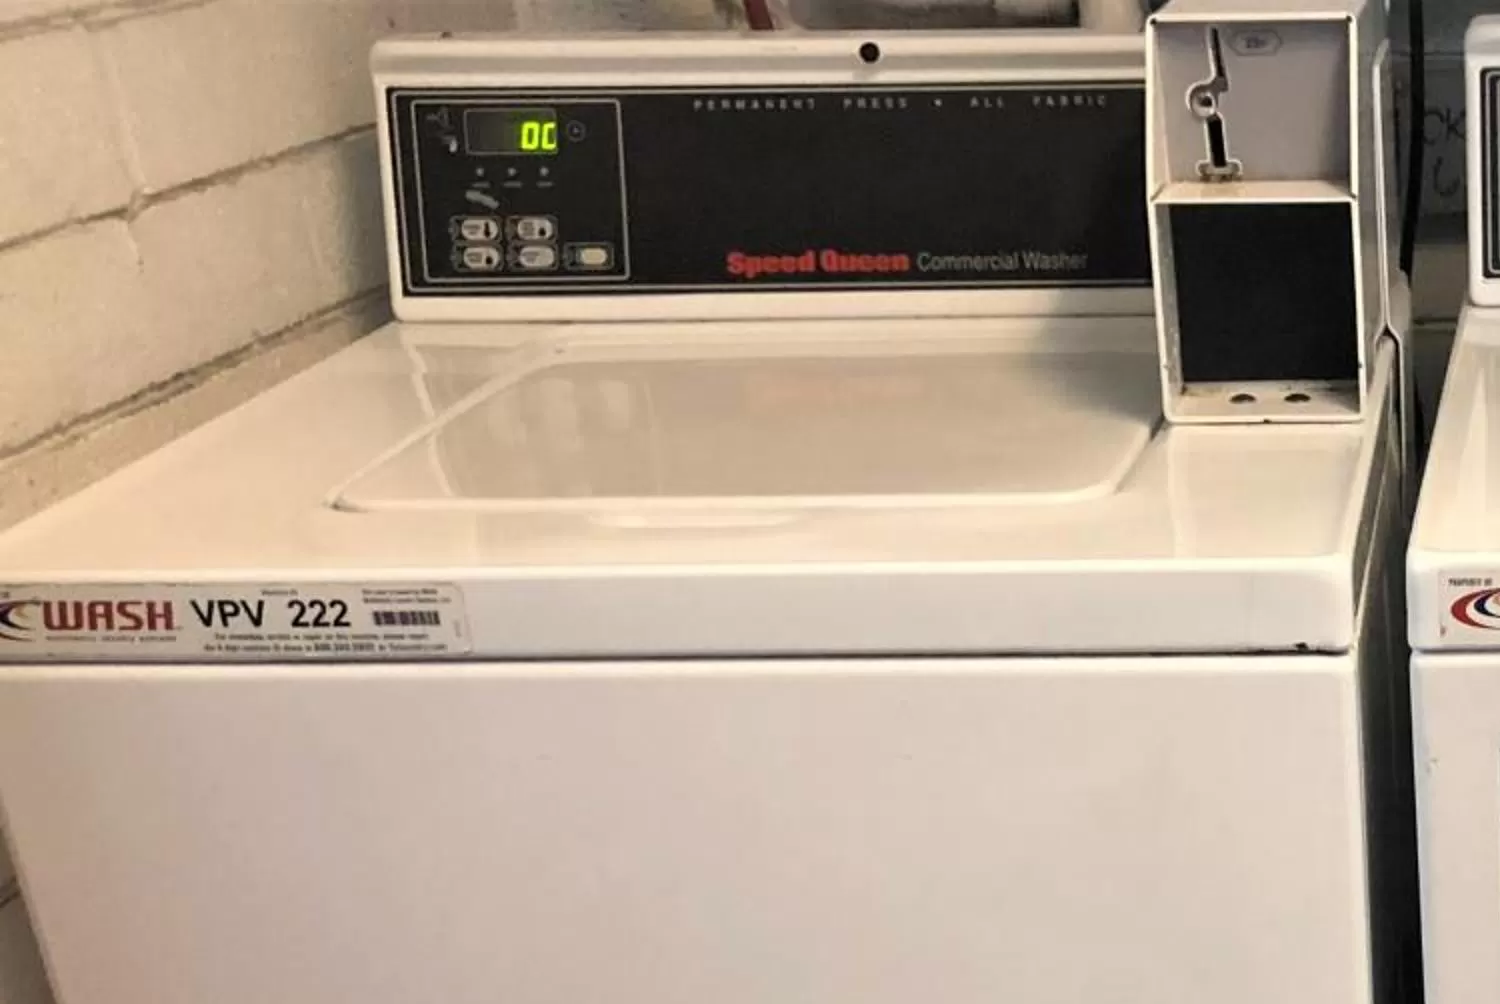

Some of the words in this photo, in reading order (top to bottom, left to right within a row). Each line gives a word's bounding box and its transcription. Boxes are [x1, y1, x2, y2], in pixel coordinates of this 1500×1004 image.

[693, 97, 816, 111] PERMANENT
[843, 97, 907, 110] PRESS
[970, 96, 1004, 109] ALL
[1033, 95, 1107, 108] FABRIC
[726, 250, 815, 279] Speed
[820, 249, 911, 273] Queen
[916, 251, 1020, 272] Commercial
[1023, 249, 1090, 270] Washer
[42, 600, 175, 631] WASH
[190, 599, 265, 628] VPV
[287, 599, 352, 628] 222
